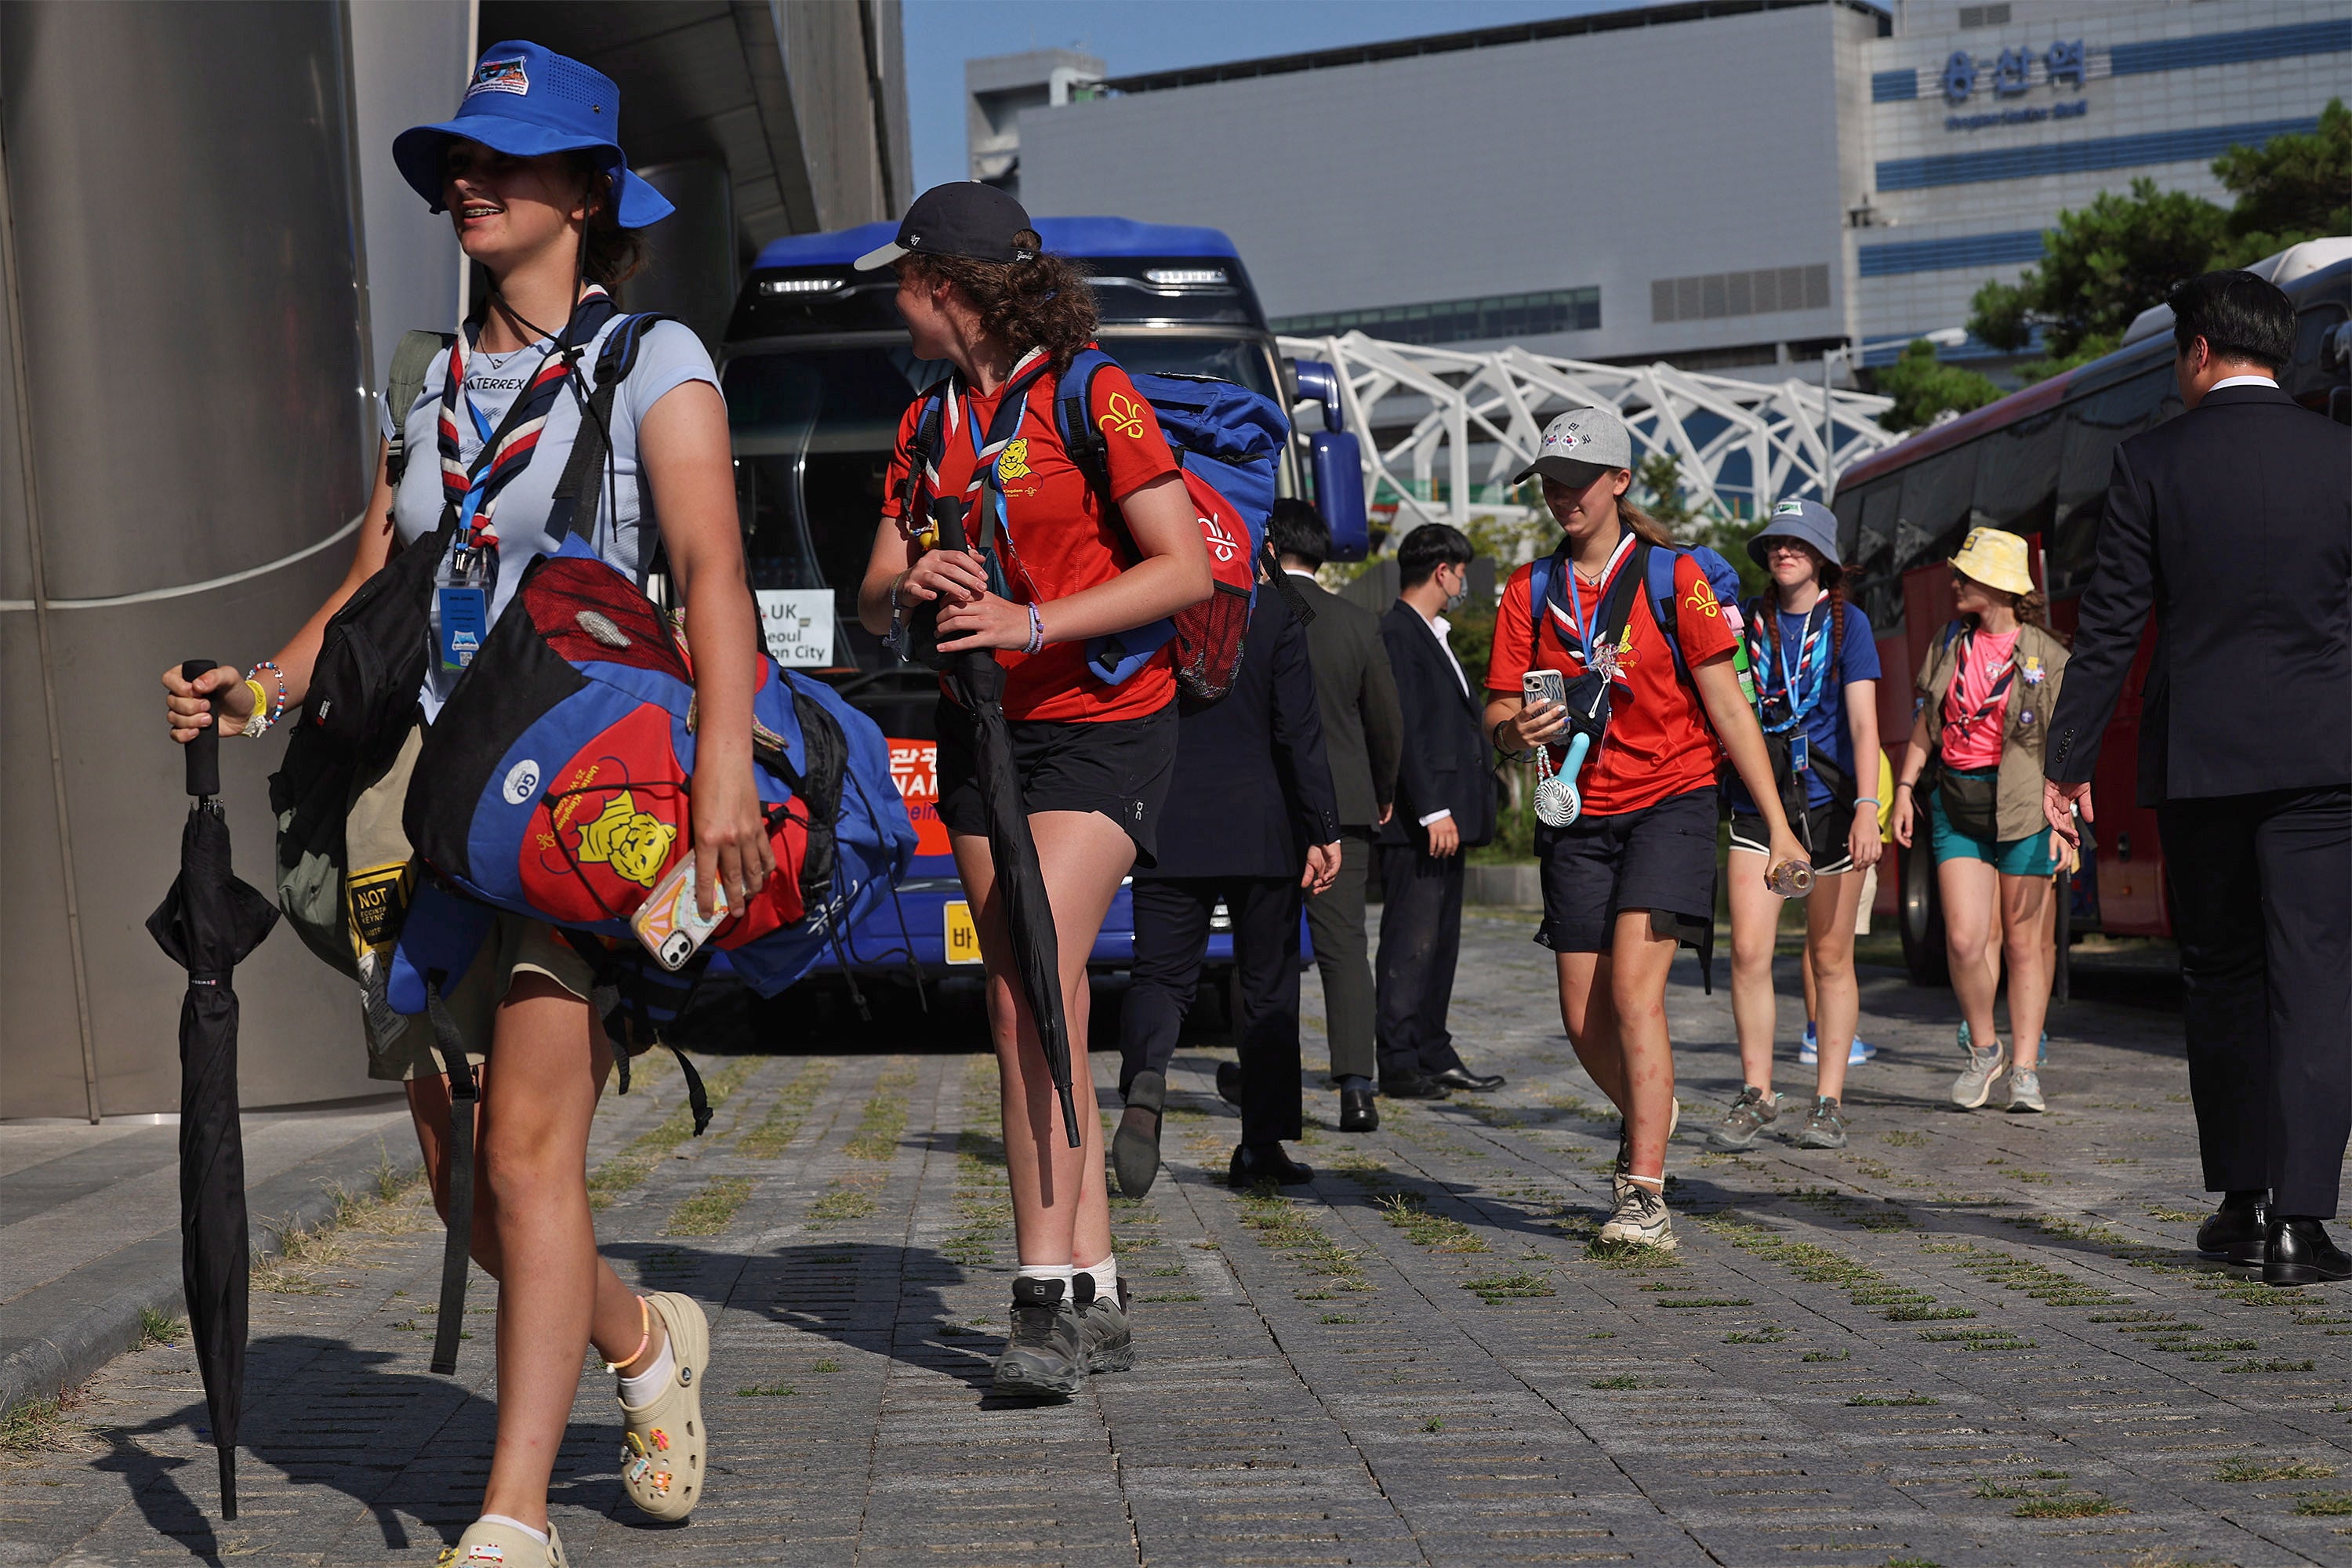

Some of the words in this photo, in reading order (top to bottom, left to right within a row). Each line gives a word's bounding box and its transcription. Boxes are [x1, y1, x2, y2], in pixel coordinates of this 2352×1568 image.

[1945, 38, 2085, 99] 용산역
[477, 377, 525, 390] TERREX
[771, 604, 797, 620] UK
[768, 630, 801, 643] eoul
[771, 648, 789, 659] on
[795, 645, 825, 661] City
[517, 773, 536, 797] GO
[575, 769, 586, 781] 25
[581, 765, 599, 790] Unite
[557, 793, 583, 831] Kingdom
[358, 887, 387, 909] NOT
[953, 927, 972, 949] 바
